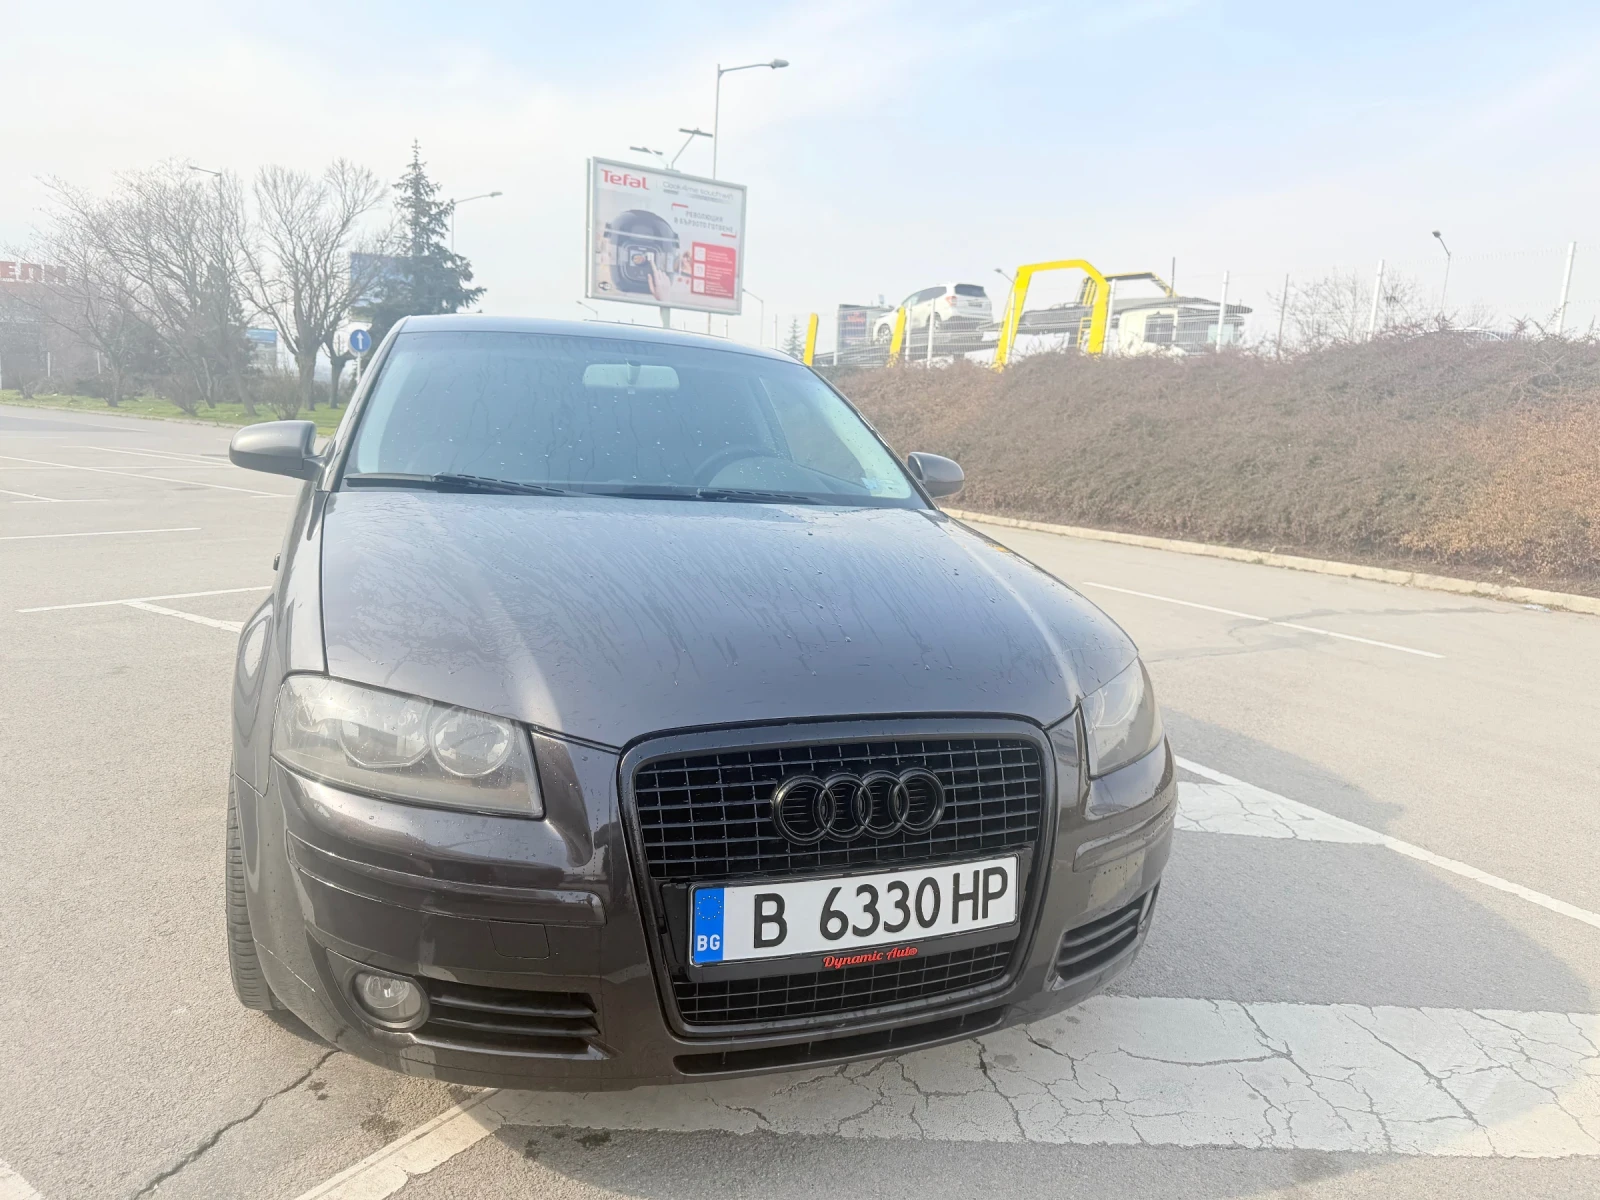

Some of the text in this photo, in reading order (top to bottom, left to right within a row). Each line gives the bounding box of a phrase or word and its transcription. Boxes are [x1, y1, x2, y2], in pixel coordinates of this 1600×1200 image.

[600, 168, 650, 190] Tefal
[754, 866, 1008, 948] B 6330 HP
[697, 934, 720, 951] BG
[823, 951, 884, 969] Dynamic
